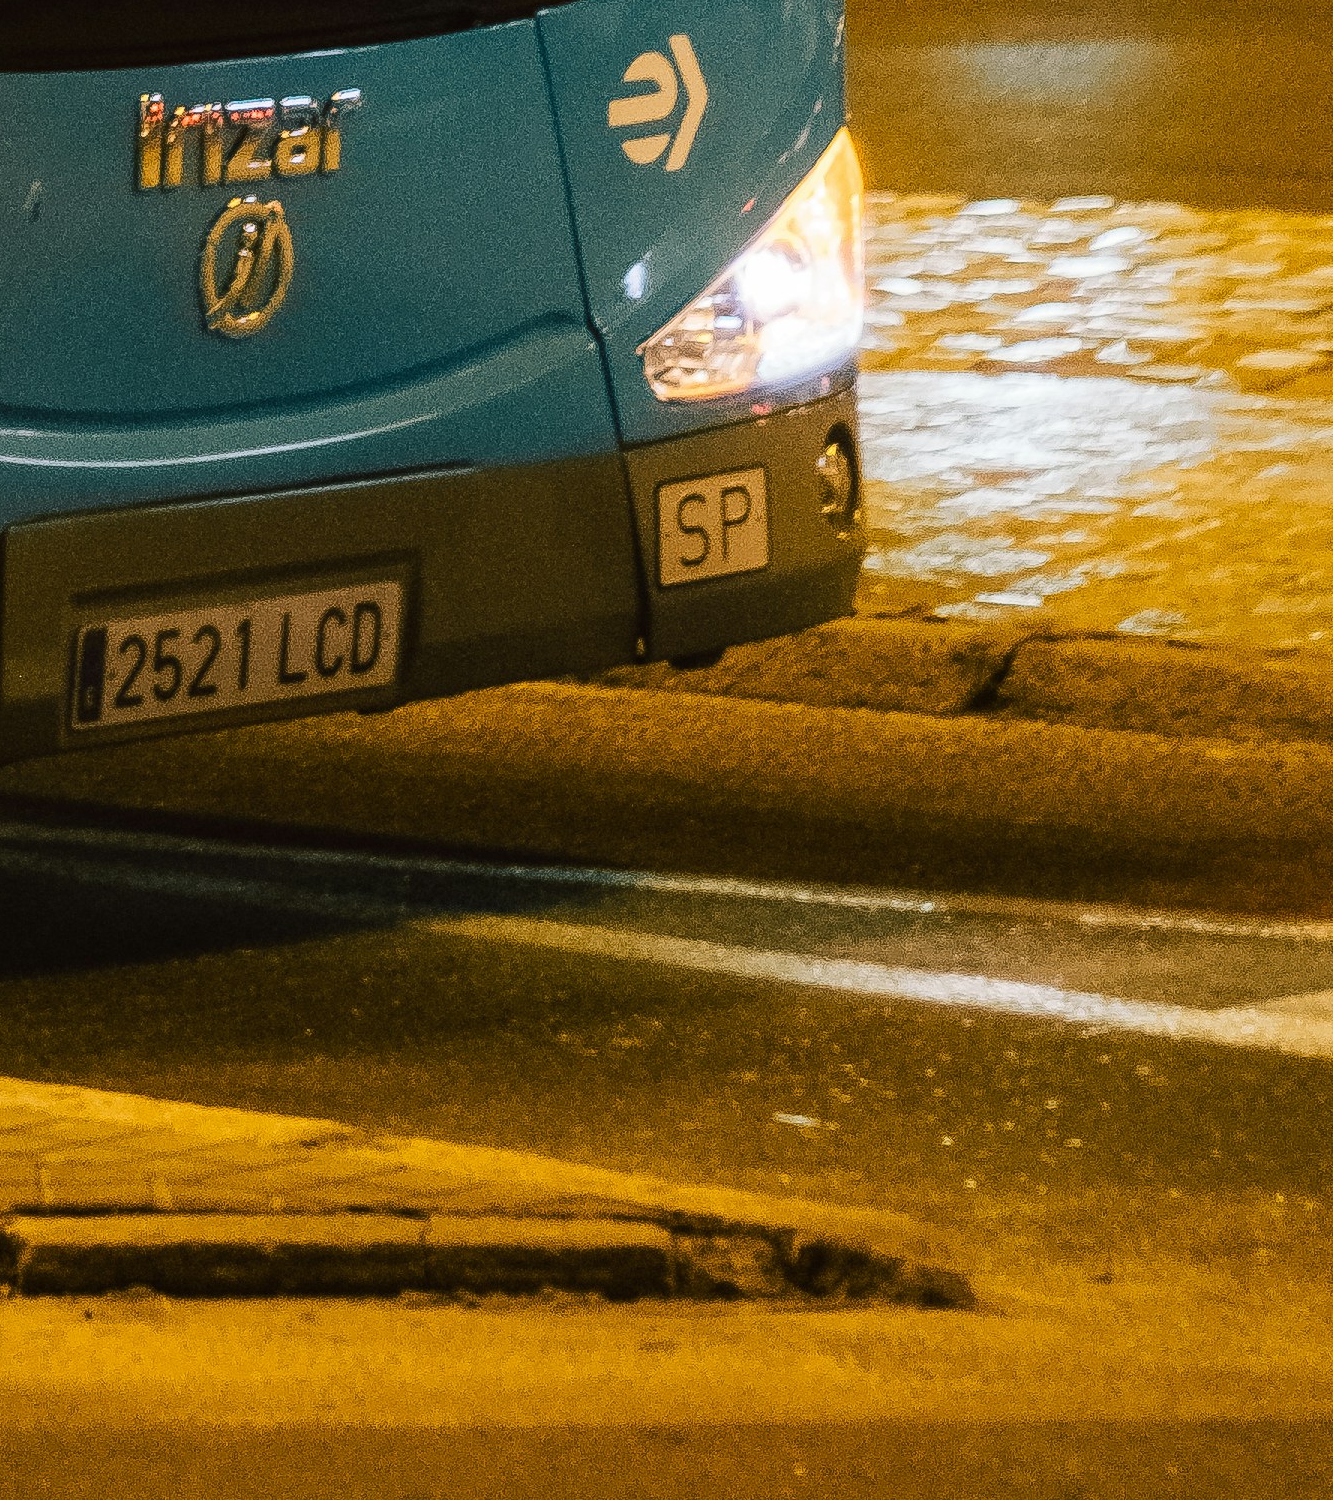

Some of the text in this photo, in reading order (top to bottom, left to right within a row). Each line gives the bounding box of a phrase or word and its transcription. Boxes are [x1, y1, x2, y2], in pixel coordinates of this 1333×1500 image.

[675, 483, 753, 568] SP
[111, 599, 382, 710] 2521 LCD
